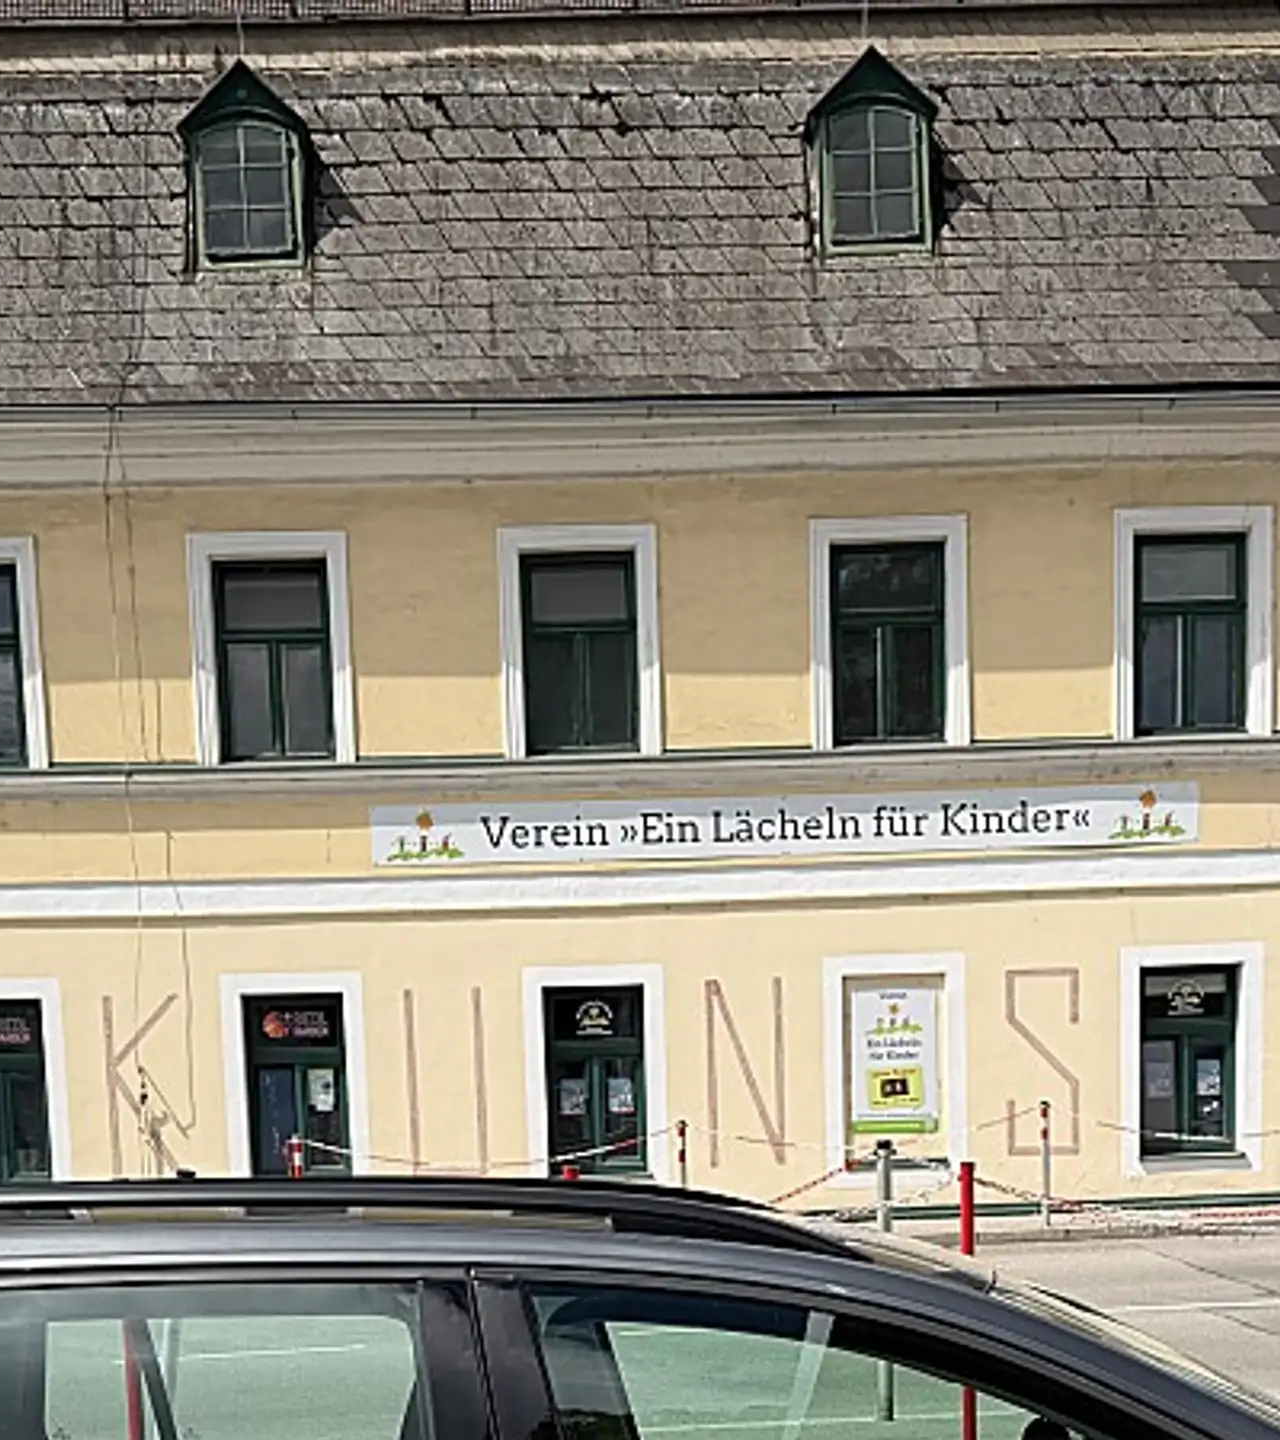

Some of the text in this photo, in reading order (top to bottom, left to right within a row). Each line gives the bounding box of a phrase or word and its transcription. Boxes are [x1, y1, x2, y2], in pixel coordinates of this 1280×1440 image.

[480, 814, 609, 848] Verein
[712, 806, 861, 843] Lächeln
[873, 805, 929, 837] für
